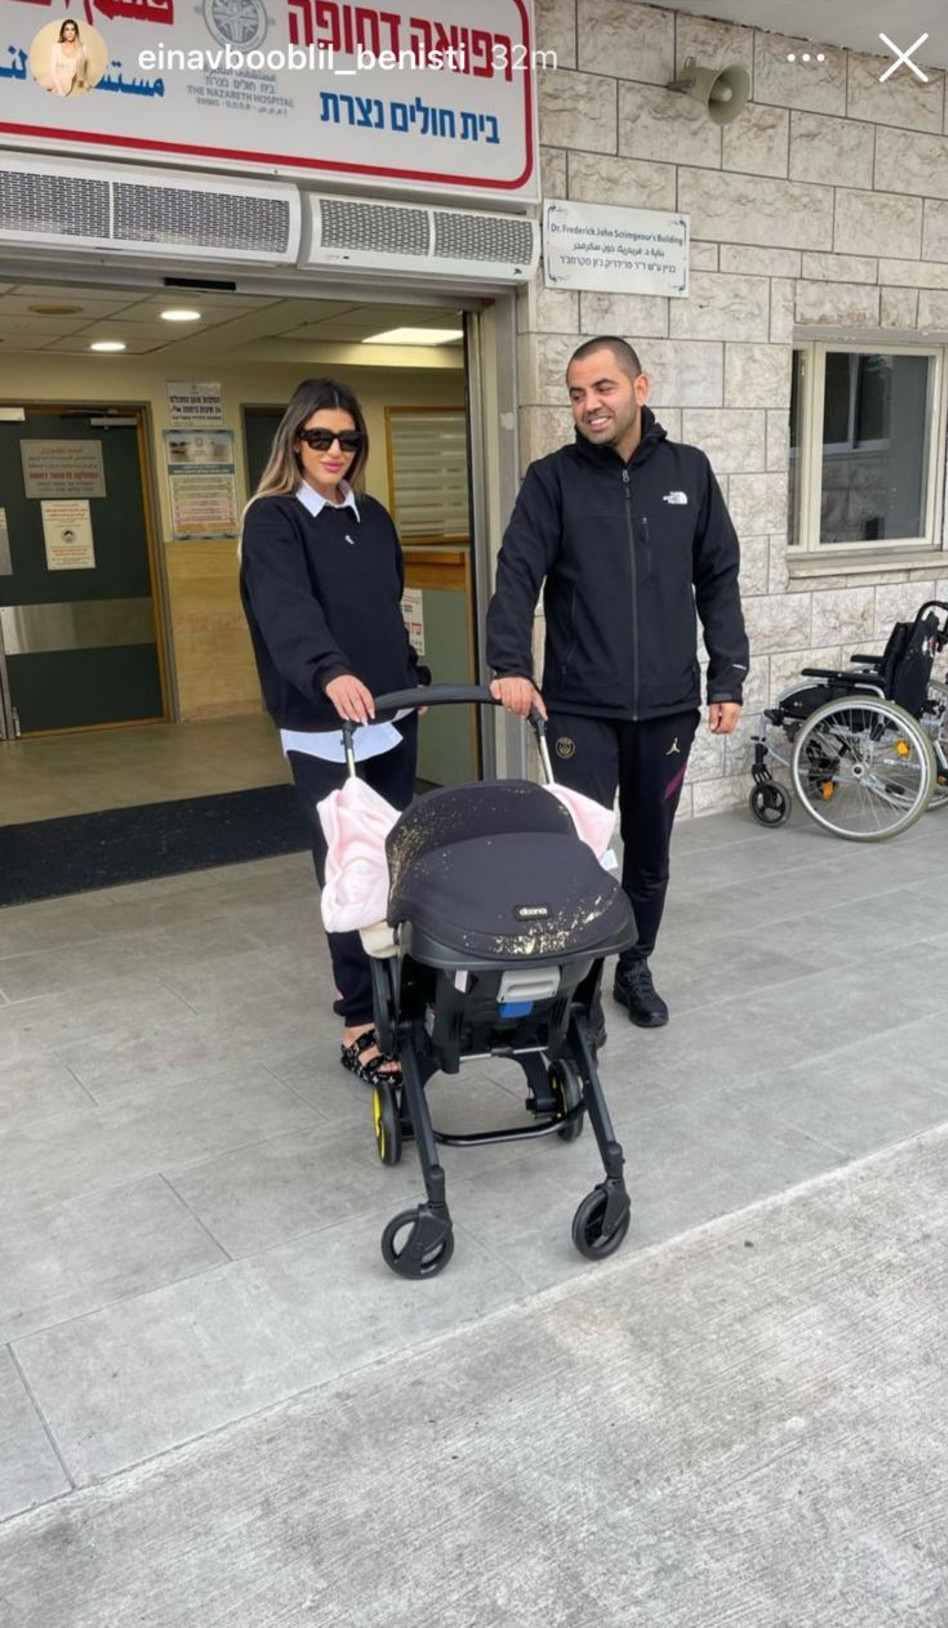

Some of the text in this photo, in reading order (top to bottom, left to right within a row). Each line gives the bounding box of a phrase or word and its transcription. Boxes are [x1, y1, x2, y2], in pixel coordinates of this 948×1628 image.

[287, 0, 513, 82] רפואה דחופה
[187, 85, 294, 108] THE NAZARETH HOSPITAL
[319, 91, 500, 144] בית חולים נצרת
[550, 222, 562, 233] Dr.
[562, 223, 595, 236] Frederick
[596, 228, 613, 239] John
[657, 234, 683, 247] Building
[519, 906, 548, 916] doona
